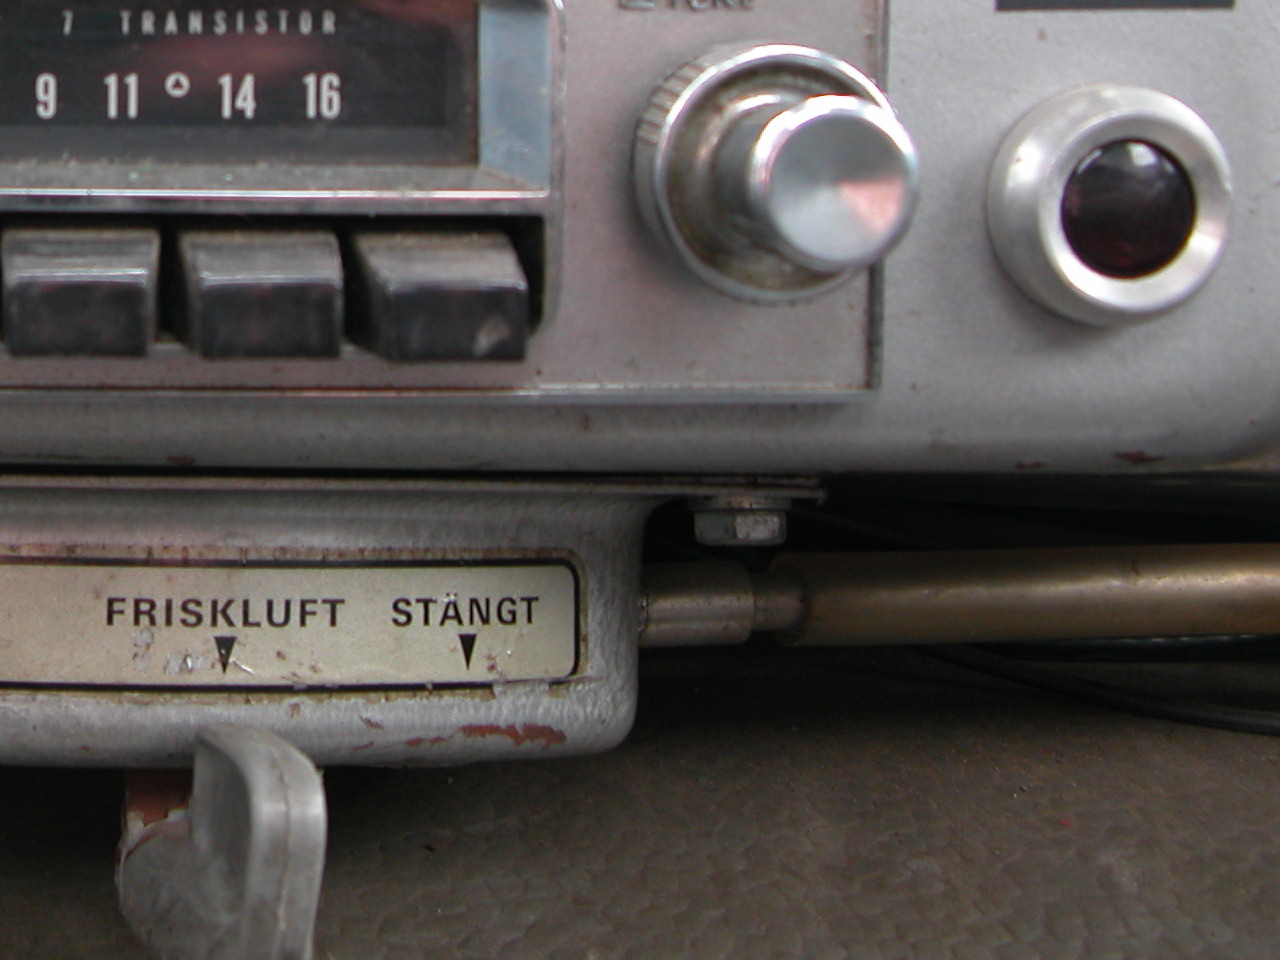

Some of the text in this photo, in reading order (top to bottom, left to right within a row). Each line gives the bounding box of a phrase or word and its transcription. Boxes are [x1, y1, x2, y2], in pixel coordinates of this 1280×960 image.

[62, 9, 74, 36] 7
[120, 9, 337, 36] TRANSISTOR
[34, 72, 58, 120] 9
[103, 72, 139, 120] 11
[218, 72, 257, 120] 14
[302, 72, 342, 120] 16
[106, 593, 540, 628] FRISKLUFT STÄNGT
